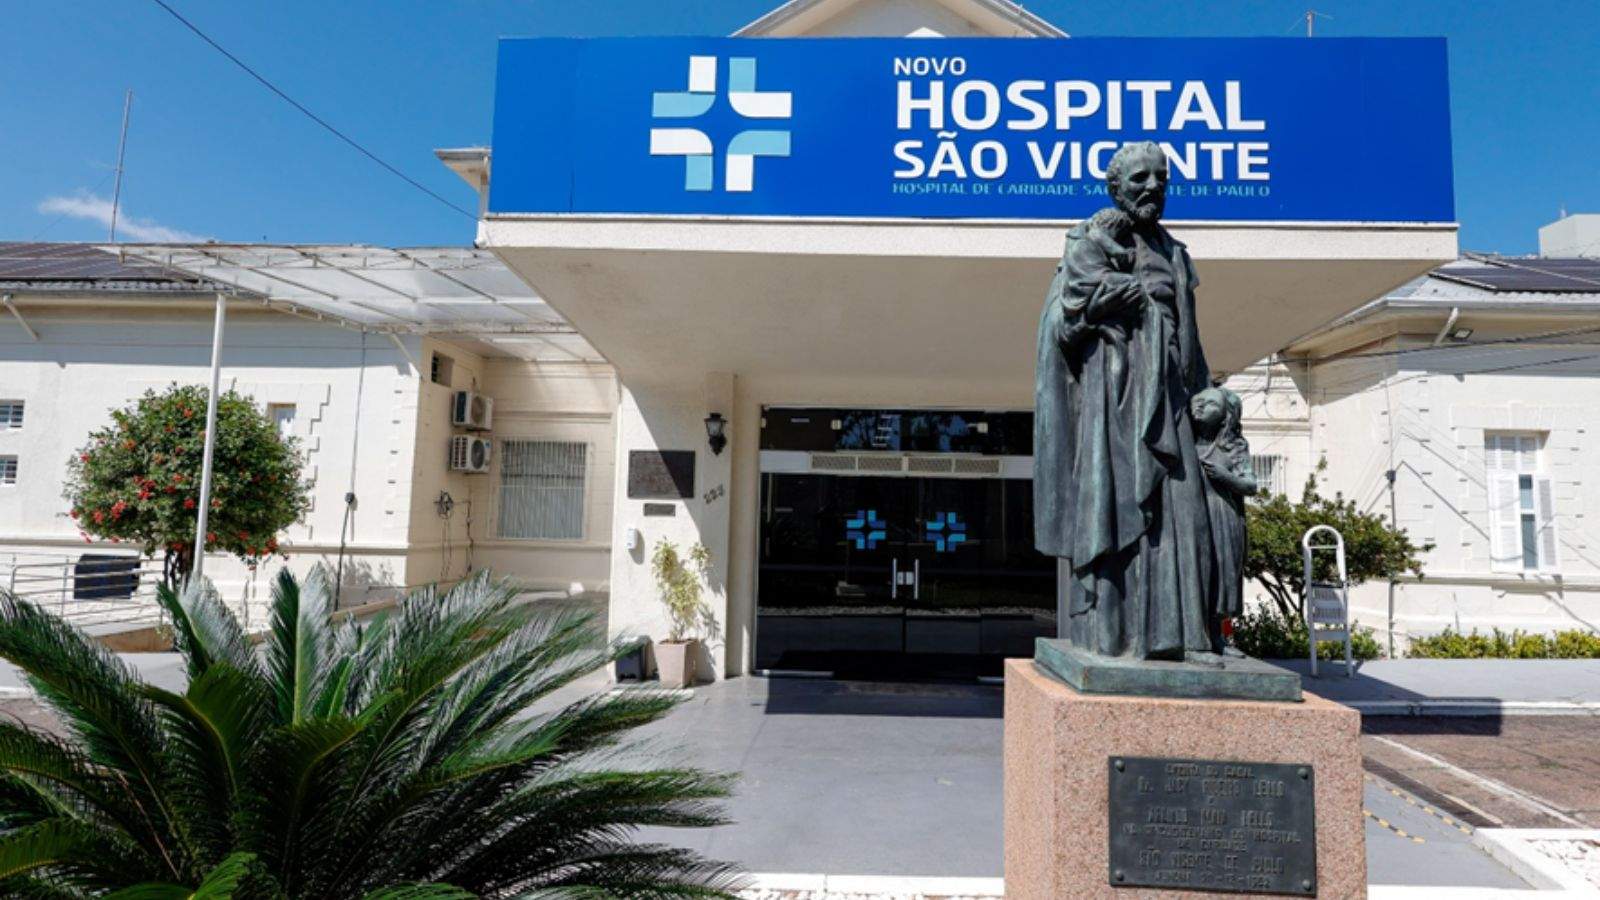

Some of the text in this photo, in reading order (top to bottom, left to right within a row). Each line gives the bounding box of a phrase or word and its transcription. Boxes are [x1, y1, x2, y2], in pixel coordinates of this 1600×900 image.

[894, 57, 967, 76] NOVO
[896, 80, 1266, 131] HOSPITAL
[893, 131, 1270, 181] SÃO VICNTE
[893, 182, 967, 195] HOSPITAL
[973, 183, 990, 195] DE
[998, 182, 1078, 196] CARIDADE
[1191, 185, 1208, 197] DE
[1216, 185, 1270, 197] PAULO
